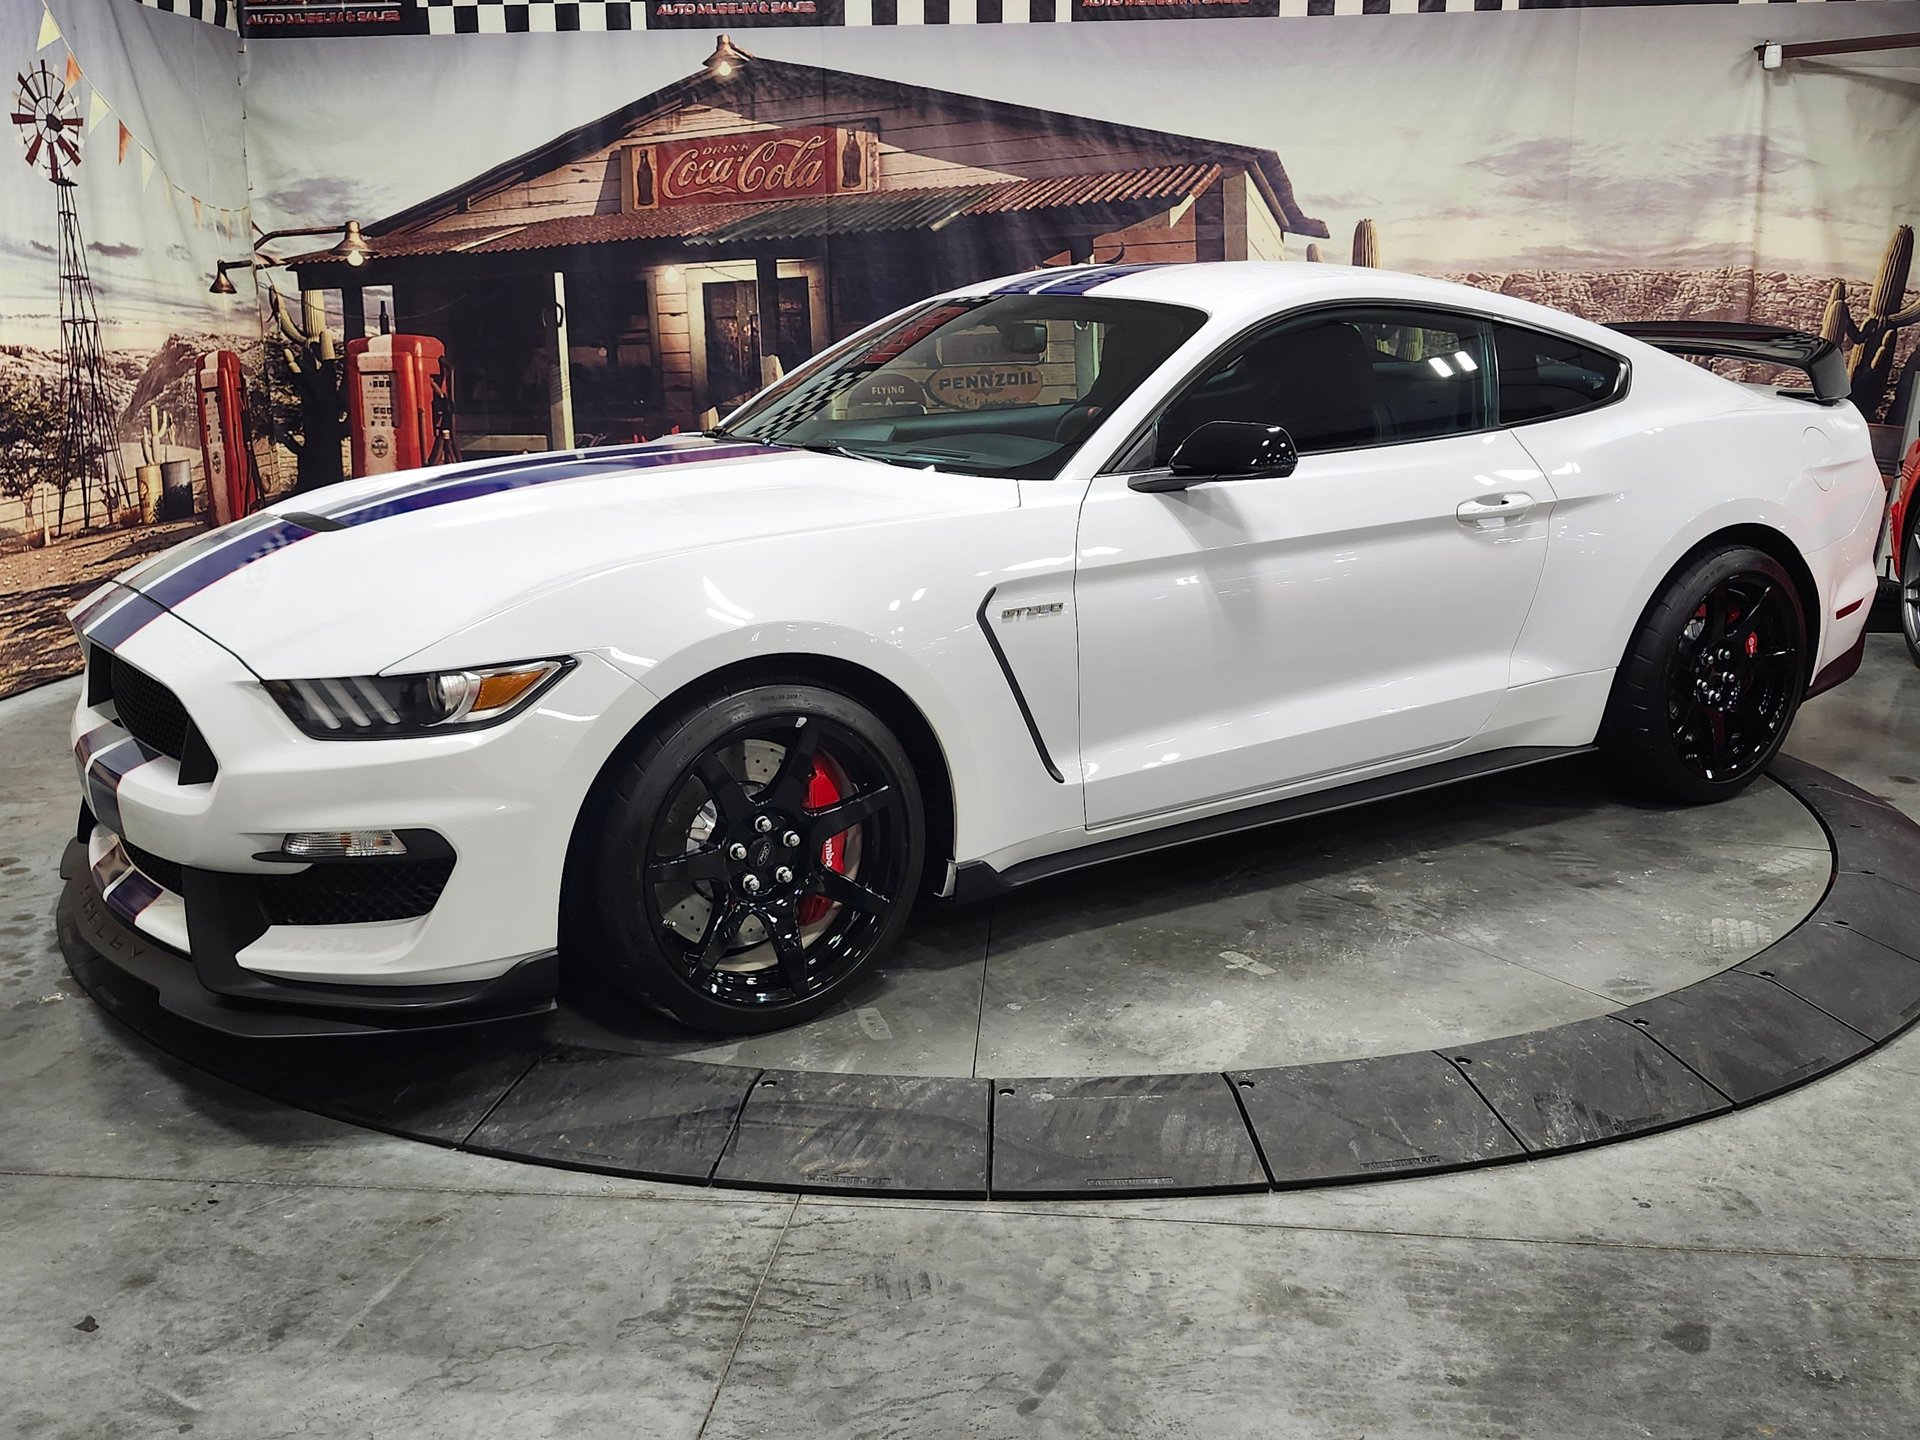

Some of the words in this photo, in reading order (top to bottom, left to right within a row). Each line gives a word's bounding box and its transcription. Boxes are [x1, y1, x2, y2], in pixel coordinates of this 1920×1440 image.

[656, 3, 696, 15] AUTO
[697, 2, 757, 15] MUSEUM
[759, 1, 769, 13] &
[771, 1, 817, 13] SALES
[246, 14, 285, 25] AUTO
[287, 12, 344, 24] MUSEUM
[346, 11, 356, 22] &
[357, 10, 401, 22] SALES
[702, 143, 750, 155] DRINK
[661, 135, 828, 199] Coca-Cola
[939, 371, 1038, 391] PENNZOIL
[871, 385, 905, 395] FLYING
